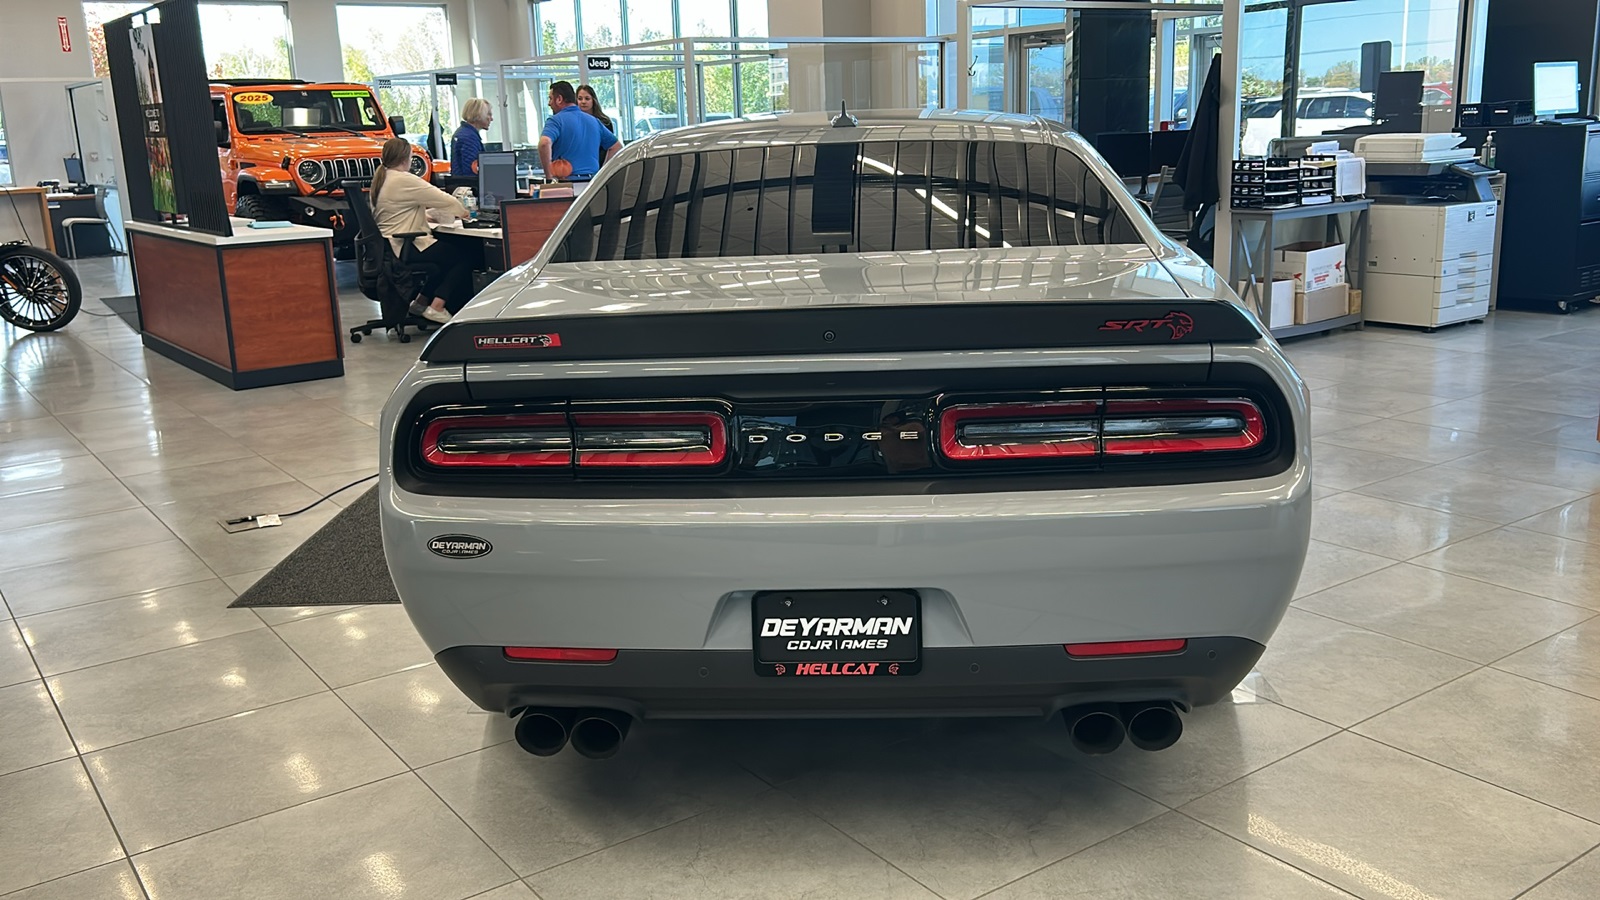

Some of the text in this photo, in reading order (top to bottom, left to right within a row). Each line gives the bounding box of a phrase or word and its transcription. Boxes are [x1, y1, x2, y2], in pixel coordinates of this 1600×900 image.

[589, 58, 608, 68] Jeep
[1098, 320, 1173, 332] SRT
[478, 336, 537, 344] HELLCAT
[748, 431, 918, 444] DODGE
[432, 541, 486, 550] DEYARMAN
[760, 616, 913, 637] DEYARMAN
[786, 640, 832, 650] CDJR
[840, 639, 889, 650] AMES
[795, 662, 880, 675] HELLCAT
